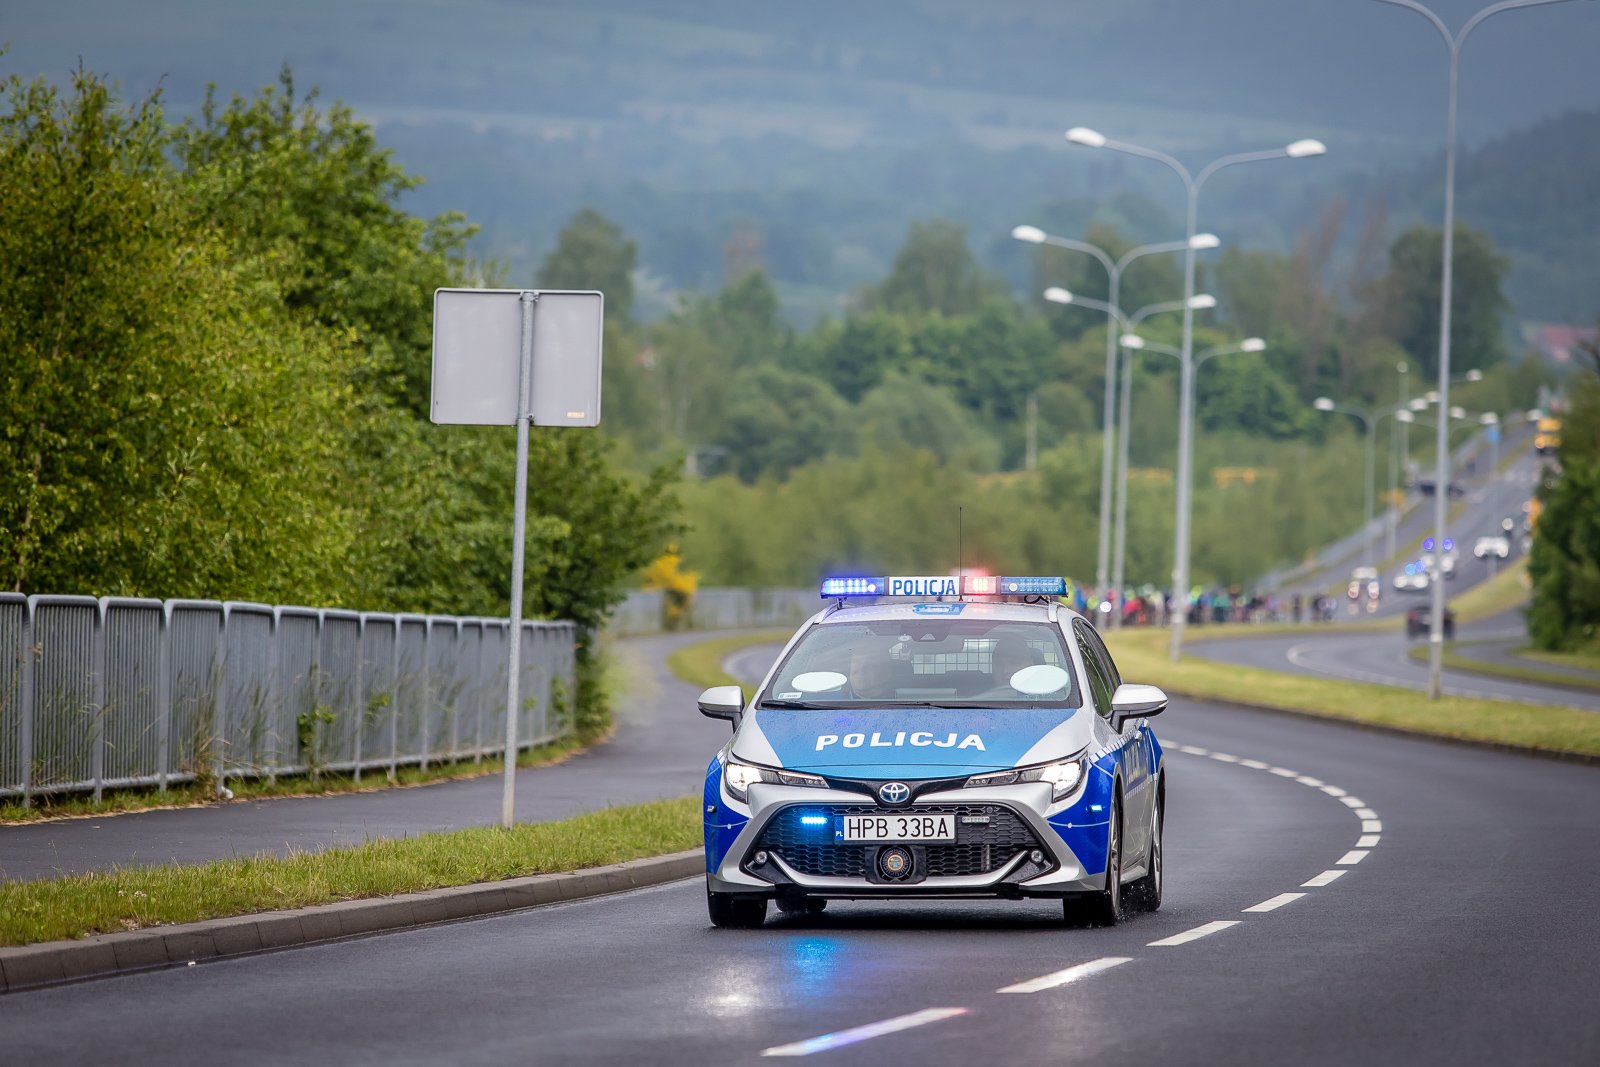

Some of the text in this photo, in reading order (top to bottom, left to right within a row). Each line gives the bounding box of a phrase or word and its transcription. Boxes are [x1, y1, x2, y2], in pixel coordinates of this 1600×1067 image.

[893, 579, 956, 596] POLICJA
[815, 731, 986, 751] POLICJA
[848, 817, 949, 838] HPB 33BA
